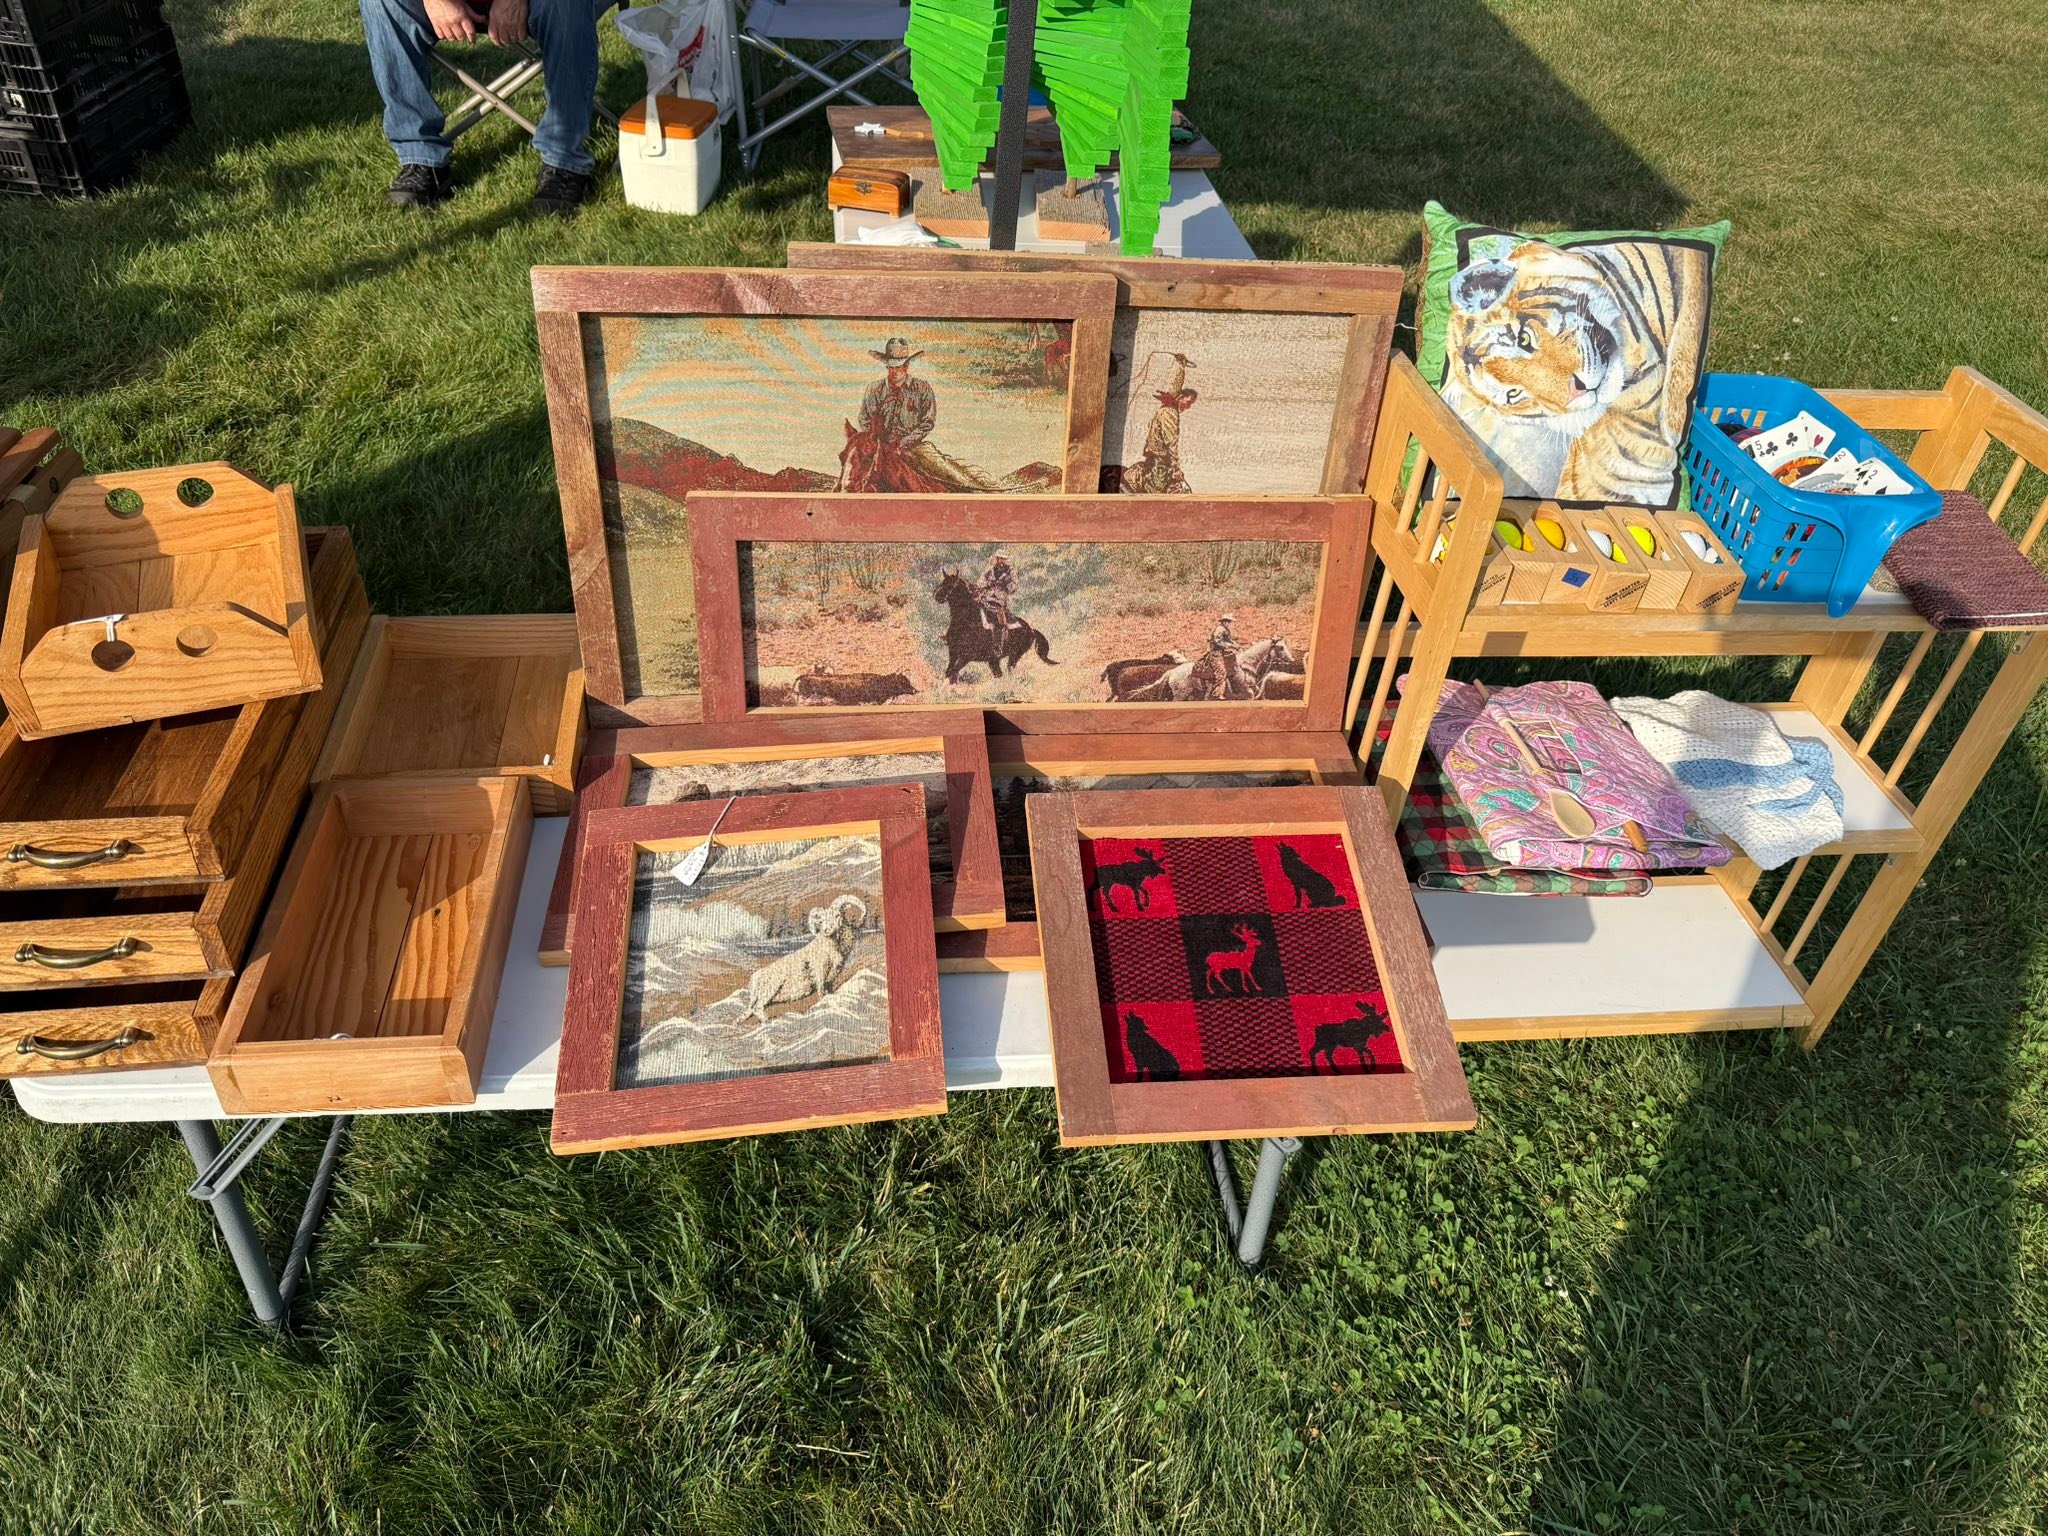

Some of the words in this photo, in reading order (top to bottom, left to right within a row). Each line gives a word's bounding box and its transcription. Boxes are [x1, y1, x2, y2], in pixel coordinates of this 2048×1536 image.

[1755, 440, 1763, 451] 5
[1838, 450, 1846, 460] 2
[1868, 469, 1878, 480] 2
[1605, 592, 1619, 600] HAND
[1619, 580, 1641, 594] CRAFTED
[1603, 596, 1618, 608] SCOTT
